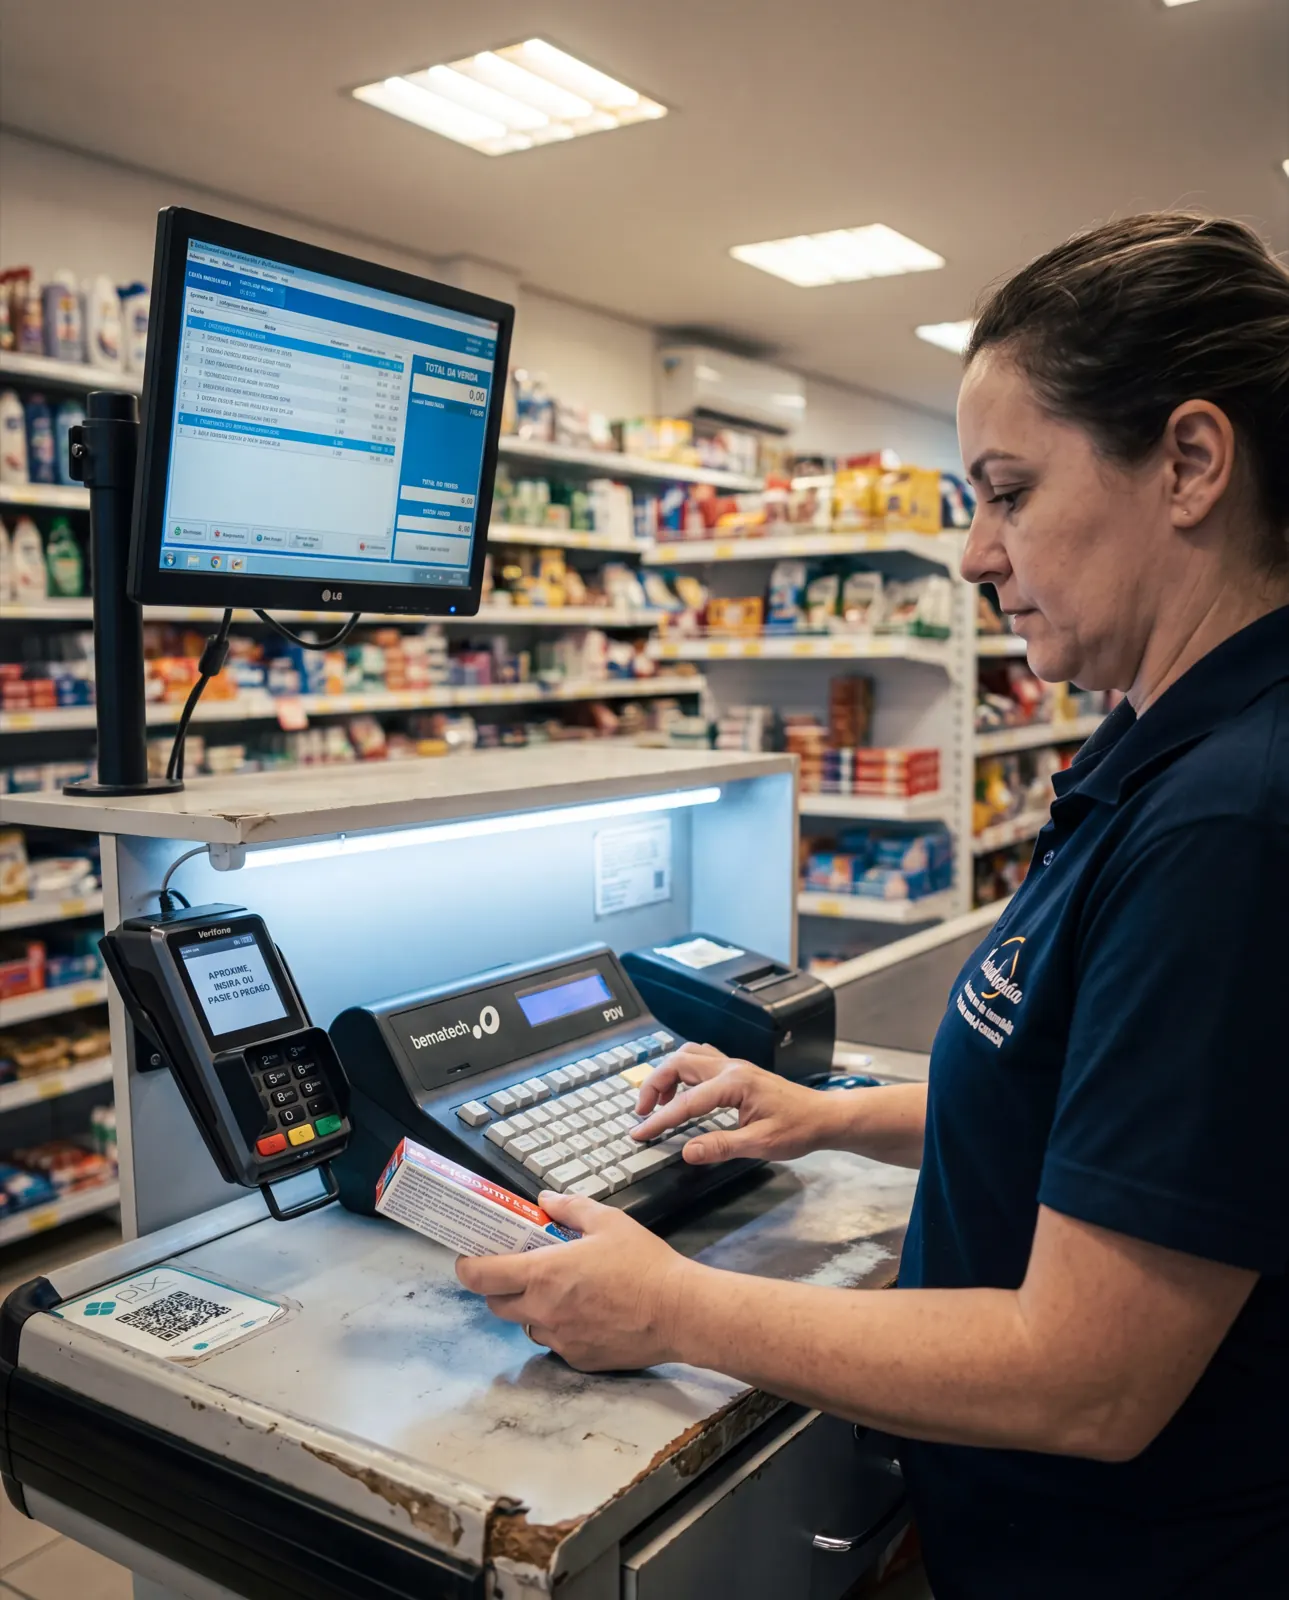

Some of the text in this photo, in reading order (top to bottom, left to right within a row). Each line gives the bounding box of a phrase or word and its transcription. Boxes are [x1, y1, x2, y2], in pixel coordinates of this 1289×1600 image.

[425, 362, 445, 375] TOTAL
[447, 368, 456, 378] DA
[469, 389, 485, 402] 0,00
[332, 591, 343, 600] LG
[198, 927, 231, 938] Verifone
[208, 964, 252, 980] APROXIME,
[213, 976, 254, 991] INSIRA OU
[207, 992, 232, 1005] PASIE
[233, 990, 239, 999] O
[602, 1006, 624, 1023] PDV
[410, 1020, 471, 1050] bematech
[290, 1047, 299, 1057] 3
[261, 1055, 270, 1065] 2
[297, 1065, 306, 1075] 6
[269, 1073, 277, 1084] 5
[305, 1083, 313, 1092] 9
[277, 1092, 285, 1102] 8
[284, 1111, 294, 1120] 0
[115, 1276, 172, 1304] pix
